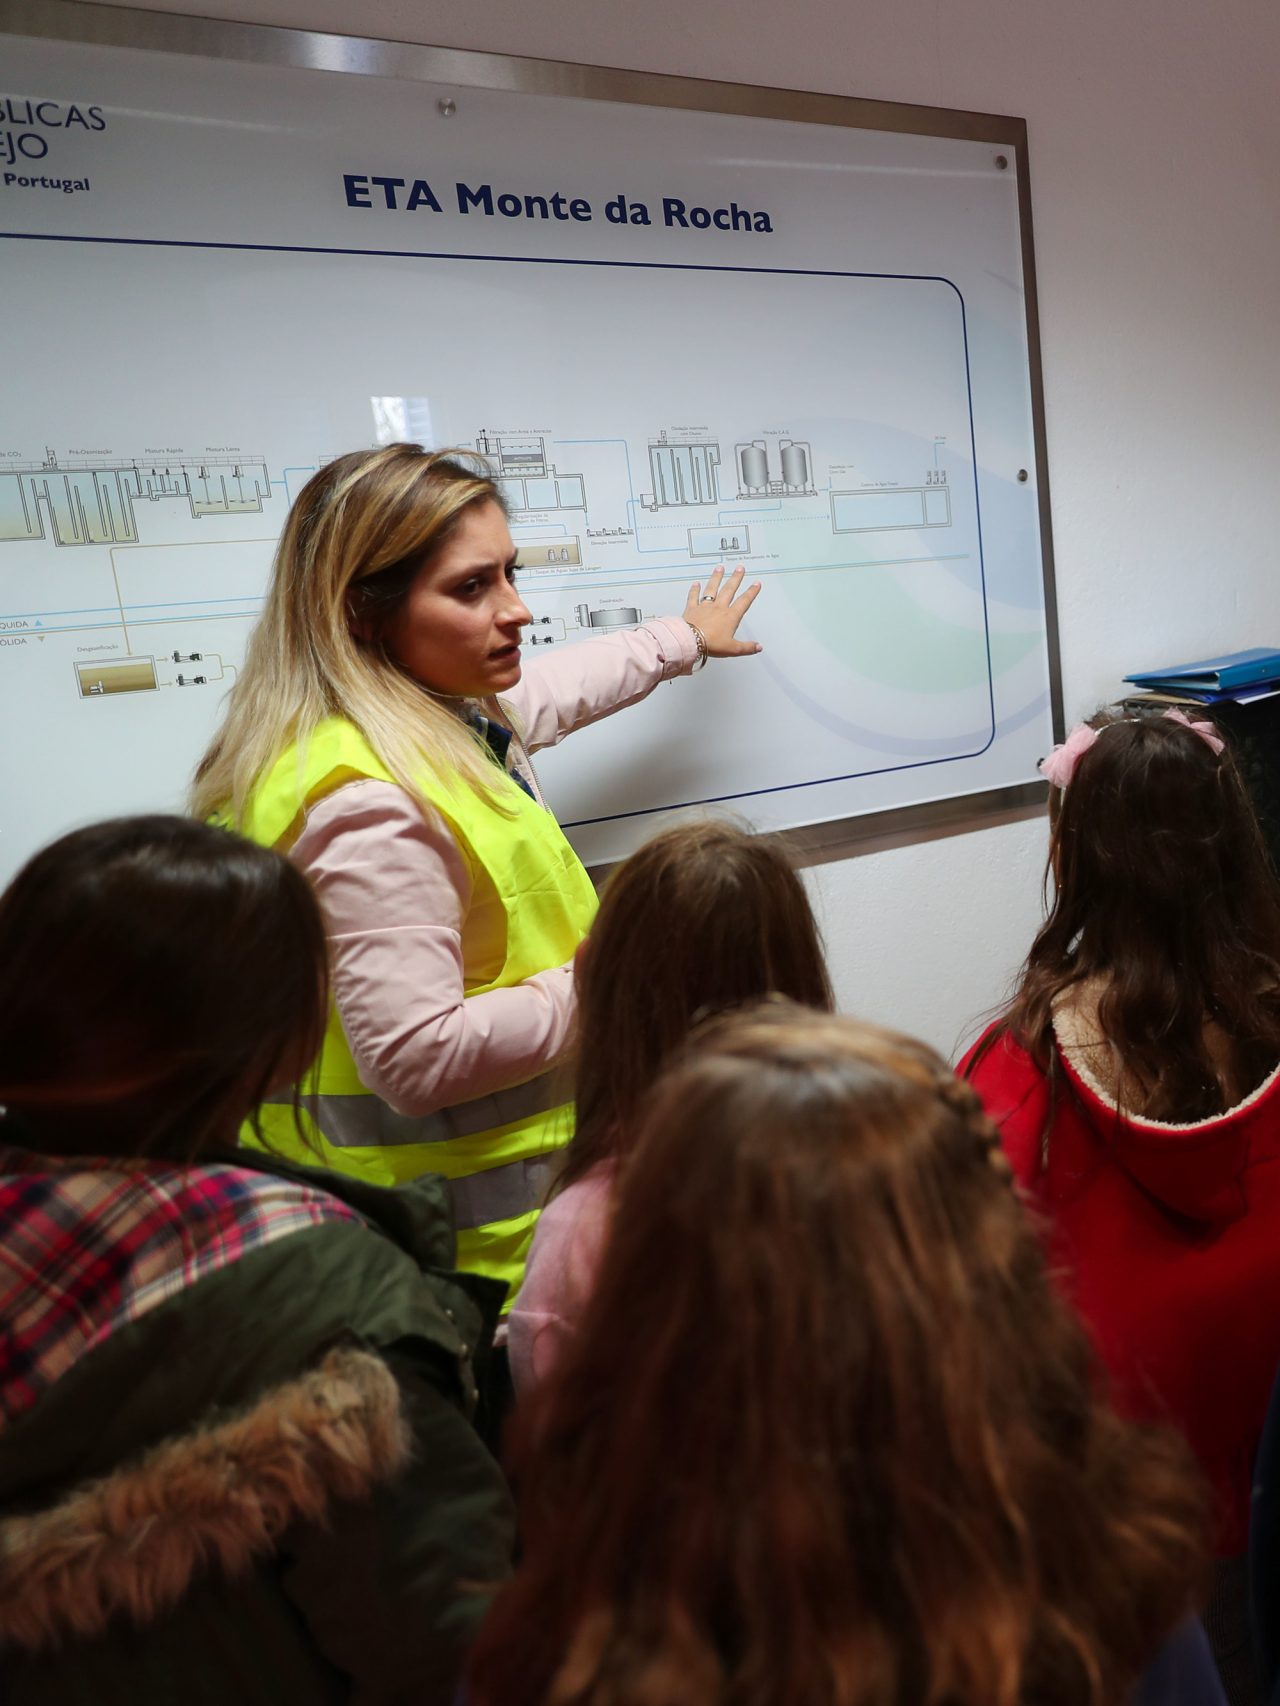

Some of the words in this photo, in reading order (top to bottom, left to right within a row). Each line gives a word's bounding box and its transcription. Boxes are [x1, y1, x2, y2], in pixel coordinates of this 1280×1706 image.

[4, 172, 90, 194] Portugal
[343, 174, 444, 213] ETA
[455, 182, 593, 222] Monte
[604, 194, 652, 226] da
[662, 197, 774, 233] Rocha
